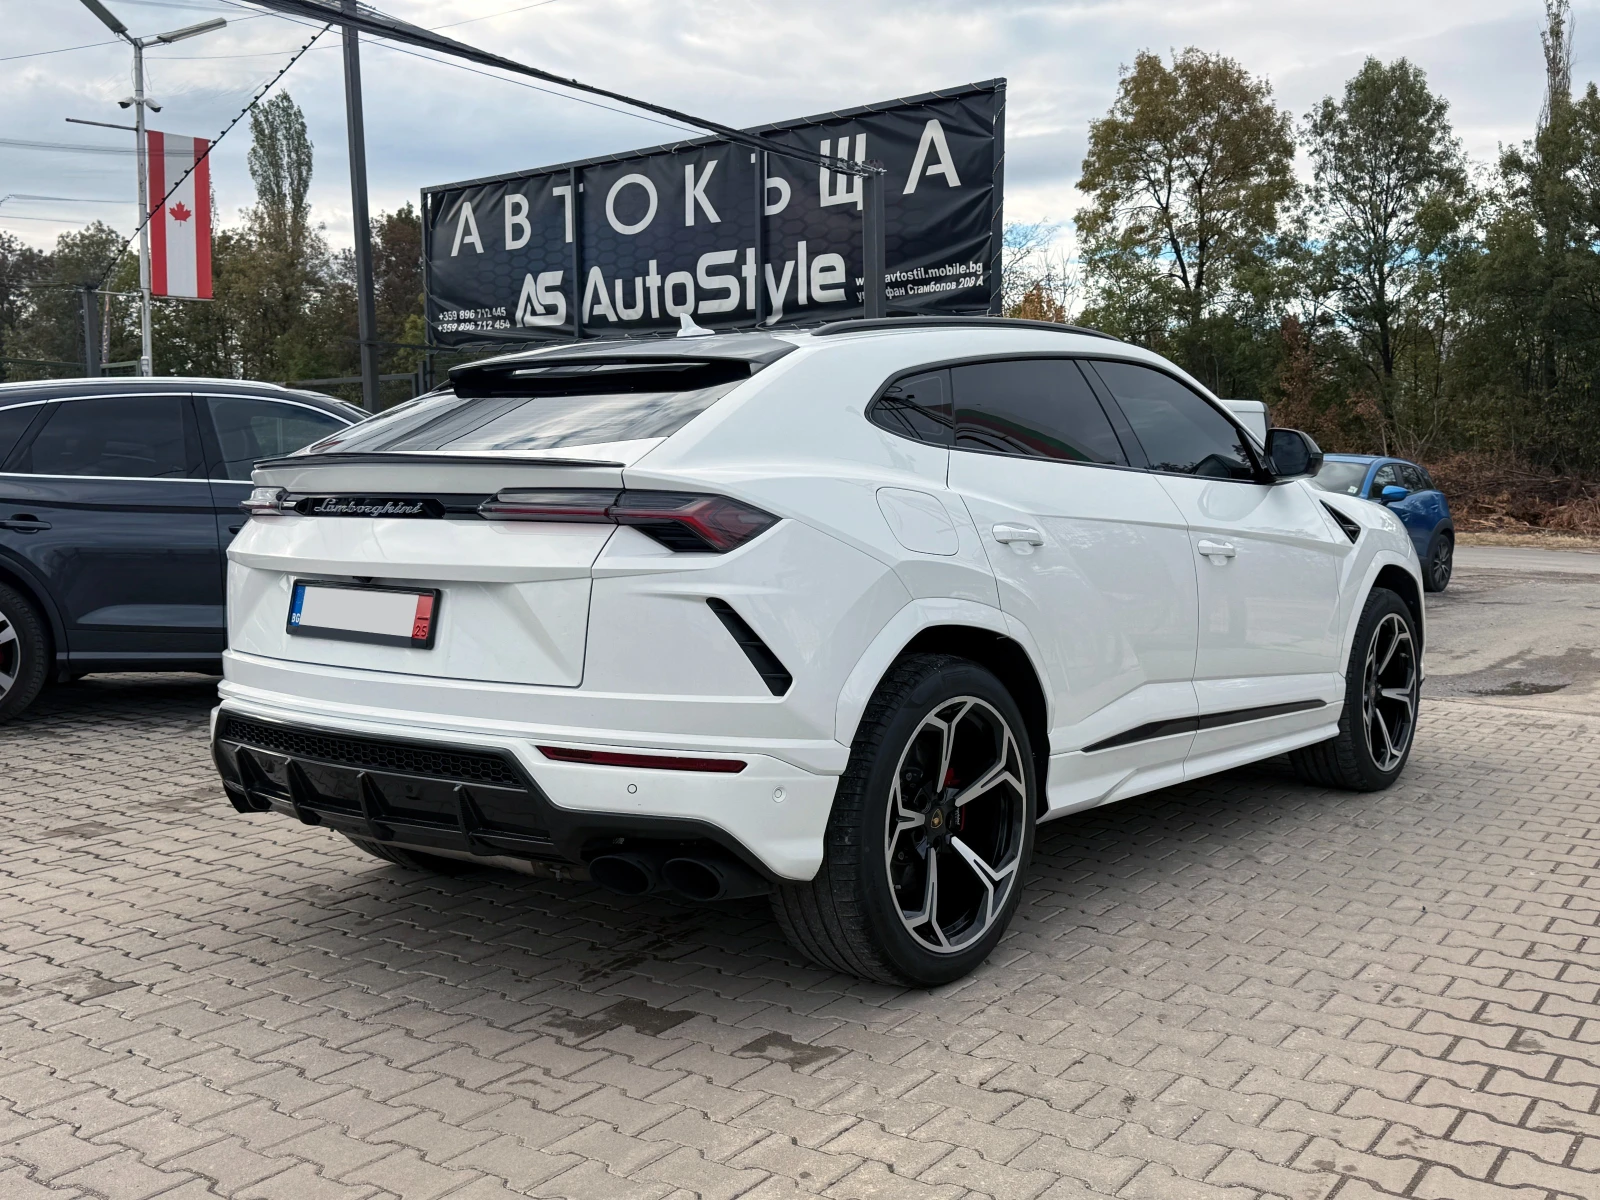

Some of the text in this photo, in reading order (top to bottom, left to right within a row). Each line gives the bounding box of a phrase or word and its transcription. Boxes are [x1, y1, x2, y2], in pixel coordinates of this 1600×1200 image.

[450, 118, 962, 257] АВТОКЪЩА
[516, 240, 848, 328] AS AutoStyle
[907, 280, 957, 295] Стамболов
[958, 276, 975, 289] 208
[438, 311, 457, 321] +359
[459, 309, 475, 319] 896
[476, 308, 492, 318] 712
[437, 320, 510, 333] +359 896 712 454
[313, 498, 424, 517] Lamborghini
[291, 612, 301, 623] BG
[414, 625, 428, 638] 25
